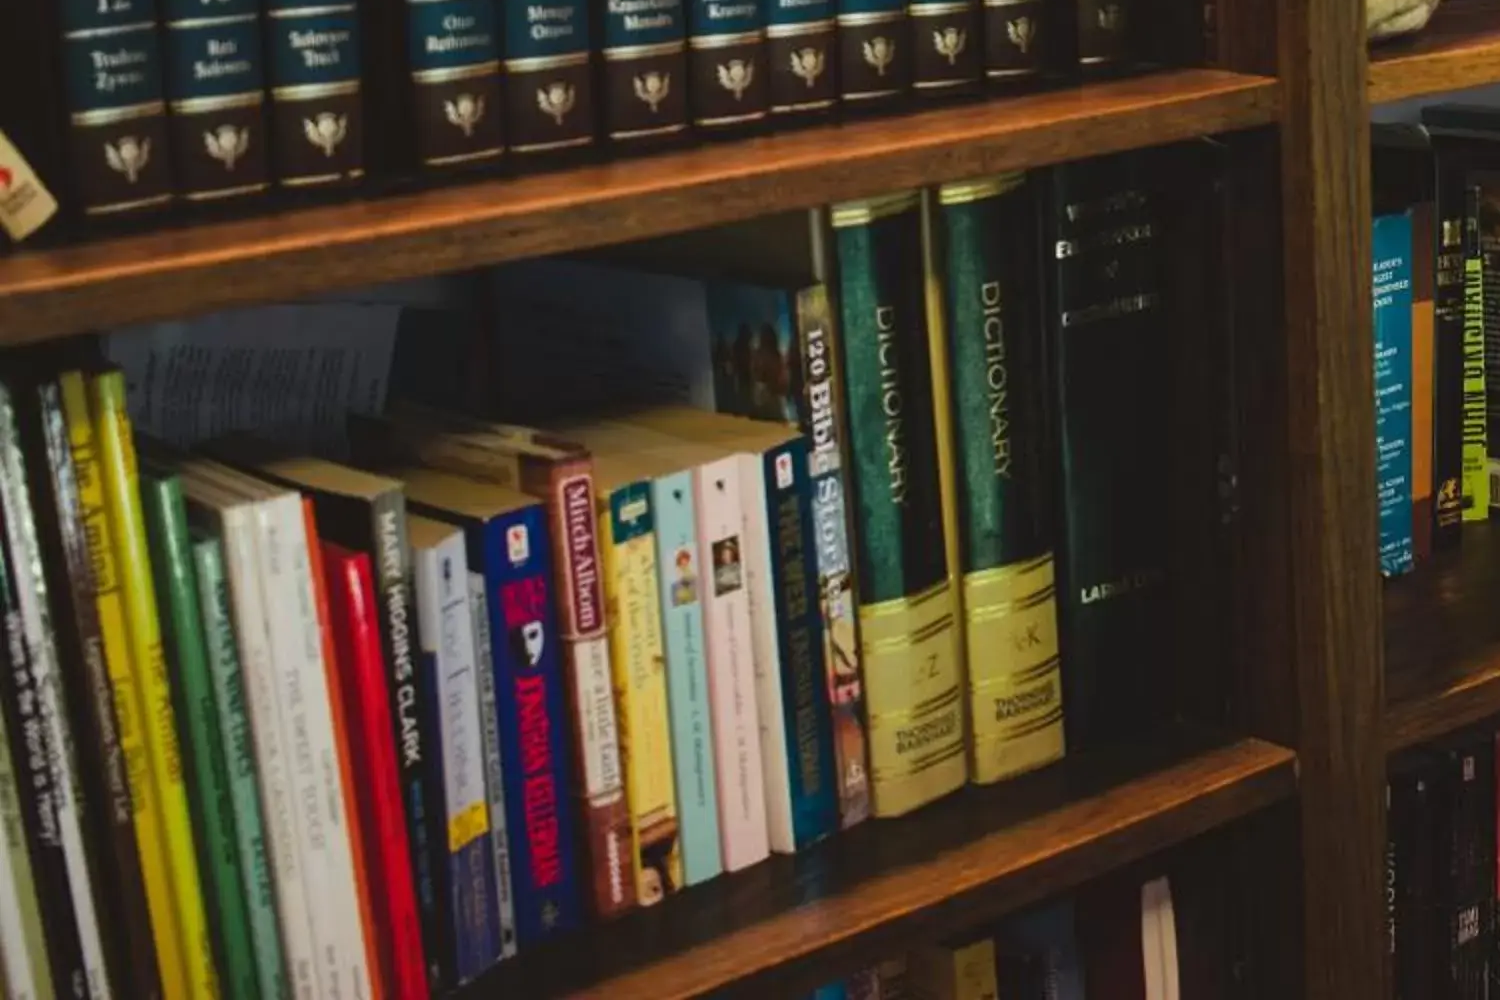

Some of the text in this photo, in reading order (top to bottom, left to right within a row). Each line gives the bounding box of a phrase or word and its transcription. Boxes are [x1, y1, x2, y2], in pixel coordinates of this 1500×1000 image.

[979, 280, 1012, 480] DICTIONARY
[1463, 271, 1484, 382] GRISHAM
[805, 328, 850, 620] 120 Bible Stories
[874, 304, 910, 507] DICTIONARY
[70, 442, 123, 599] The Aminal
[567, 484, 598, 629] Mitch Albom
[378, 509, 422, 769] MARY HIGGINS CLARK
[19, 719, 45, 771] World
[597, 701, 615, 741] little
[112, 797, 129, 824] Lie
